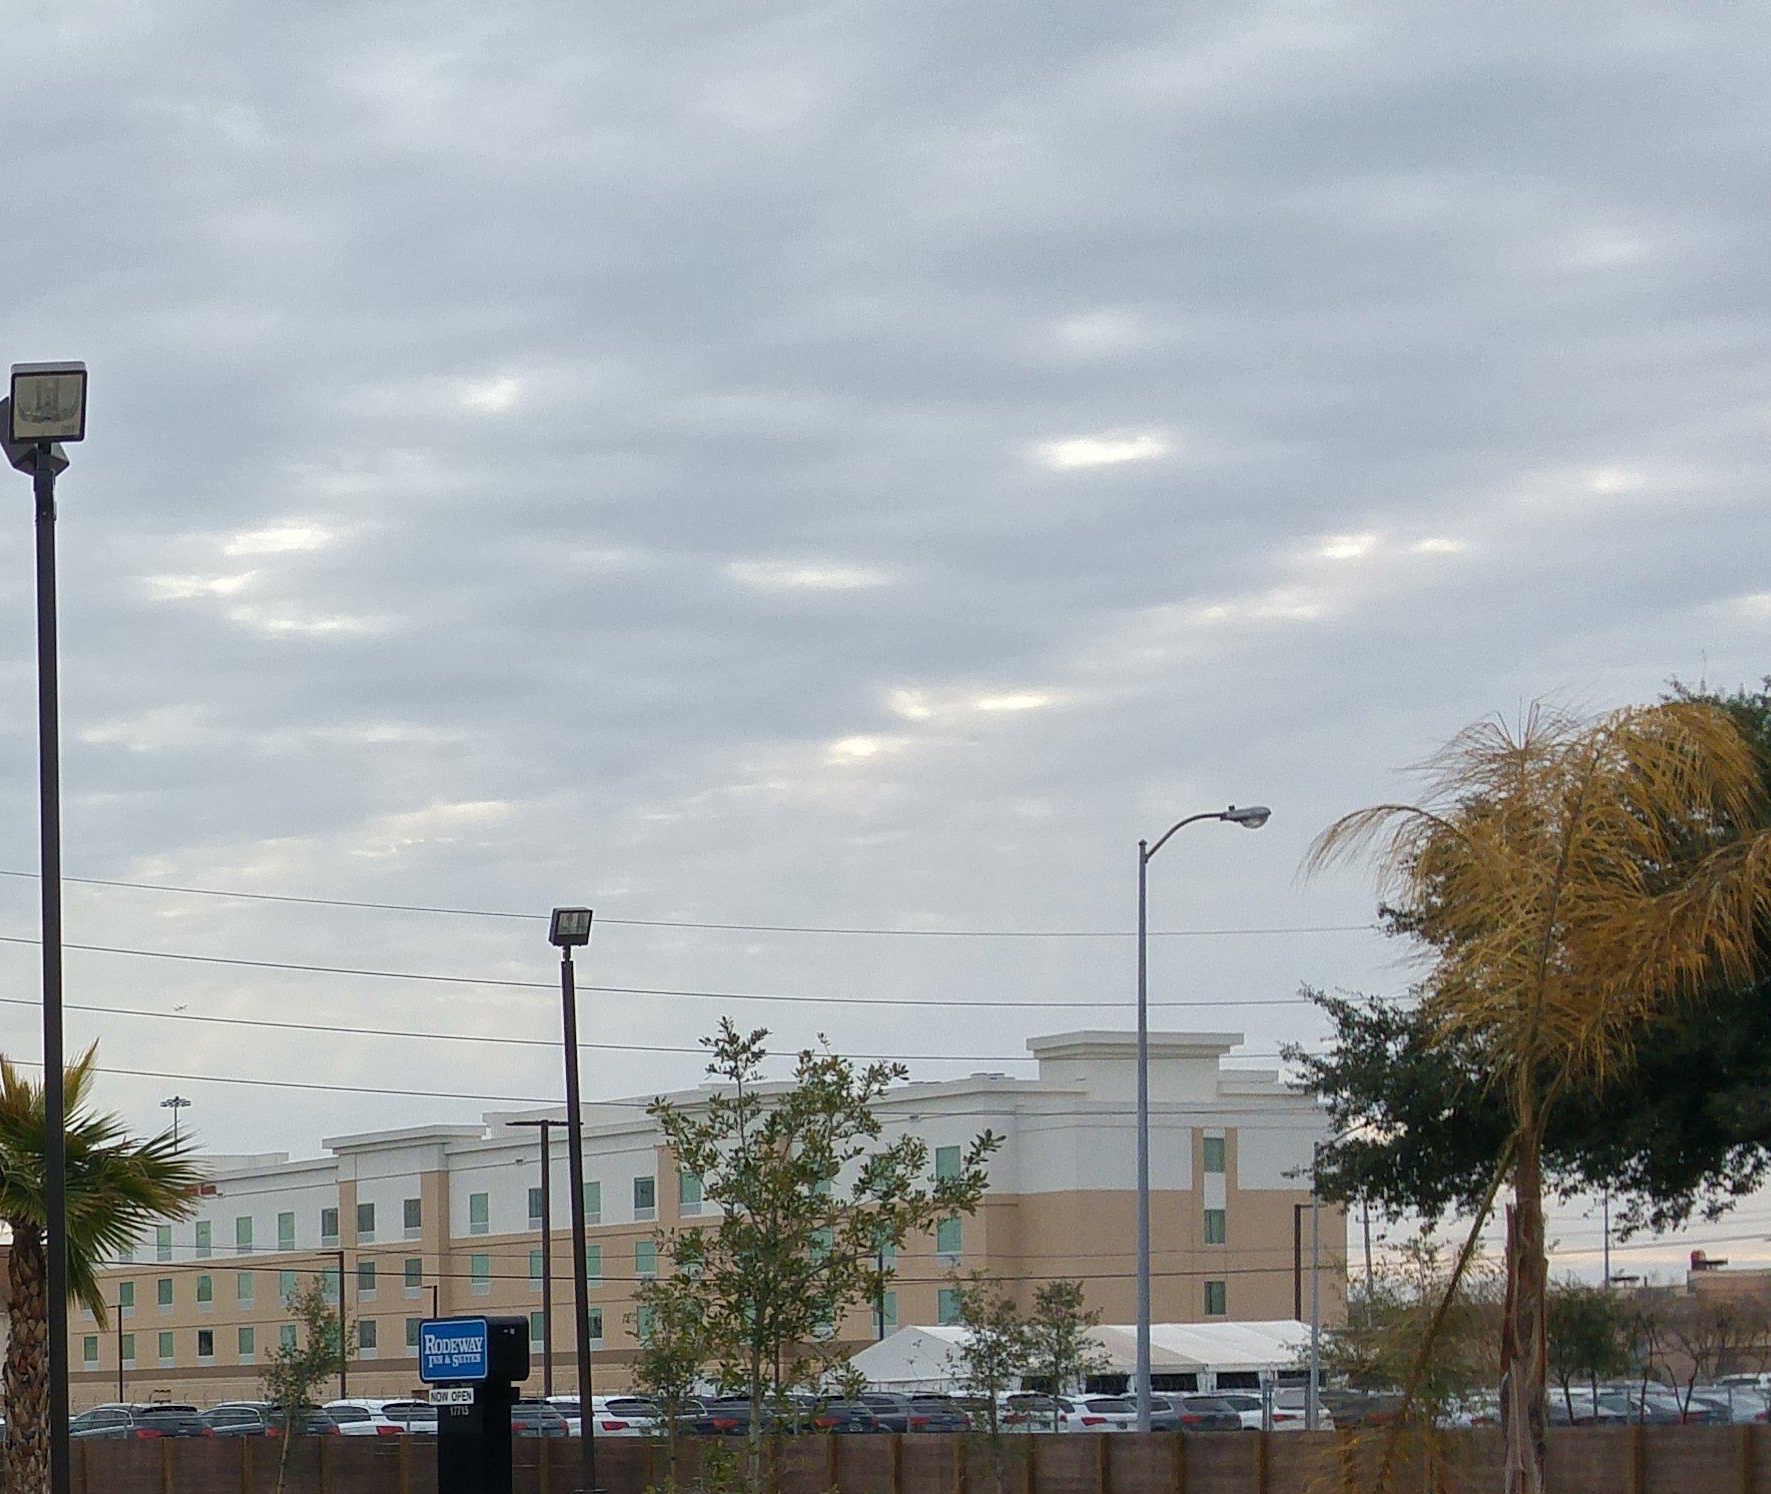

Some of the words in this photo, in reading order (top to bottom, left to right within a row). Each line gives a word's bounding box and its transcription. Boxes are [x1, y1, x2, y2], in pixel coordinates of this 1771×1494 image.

[424, 1334, 484, 1355] RODEWAY
[428, 1355, 444, 1368] INN
[444, 1354, 451, 1364] &
[452, 1353, 481, 1367] SUITES
[430, 1391, 449, 1402] NOW
[451, 1390, 472, 1402] OPEN
